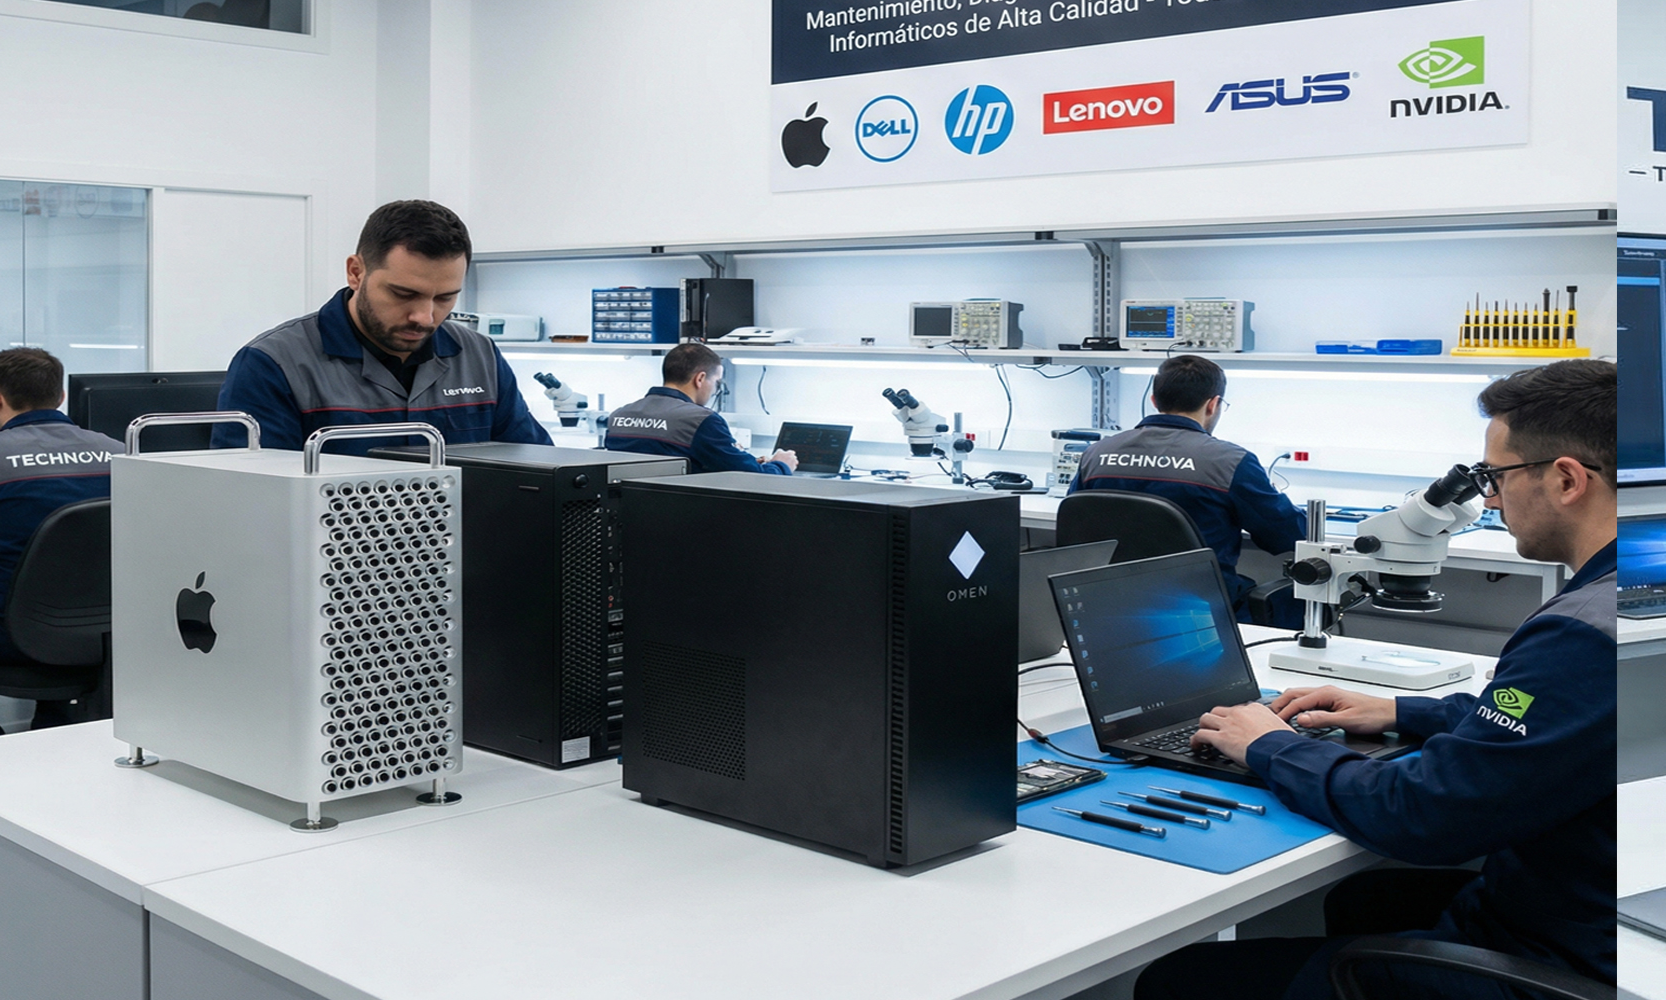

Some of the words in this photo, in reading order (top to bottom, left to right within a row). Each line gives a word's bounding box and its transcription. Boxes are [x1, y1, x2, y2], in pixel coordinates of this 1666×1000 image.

[830, 21, 958, 52] Informáticos
[965, 13, 991, 33] de
[997, 7, 1042, 30] Alta
[1049, 0, 1139, 22] Calidad
[1204, 71, 1351, 113] ASUS
[1053, 96, 1163, 123] Lenovo
[862, 119, 911, 138] DELL
[950, 84, 1008, 155] hp
[612, 416, 668, 431] TECHNOVA
[6, 450, 113, 468] TECHNOVA
[1099, 453, 1195, 471] TECHNOVA
[947, 585, 987, 602] OMEN
